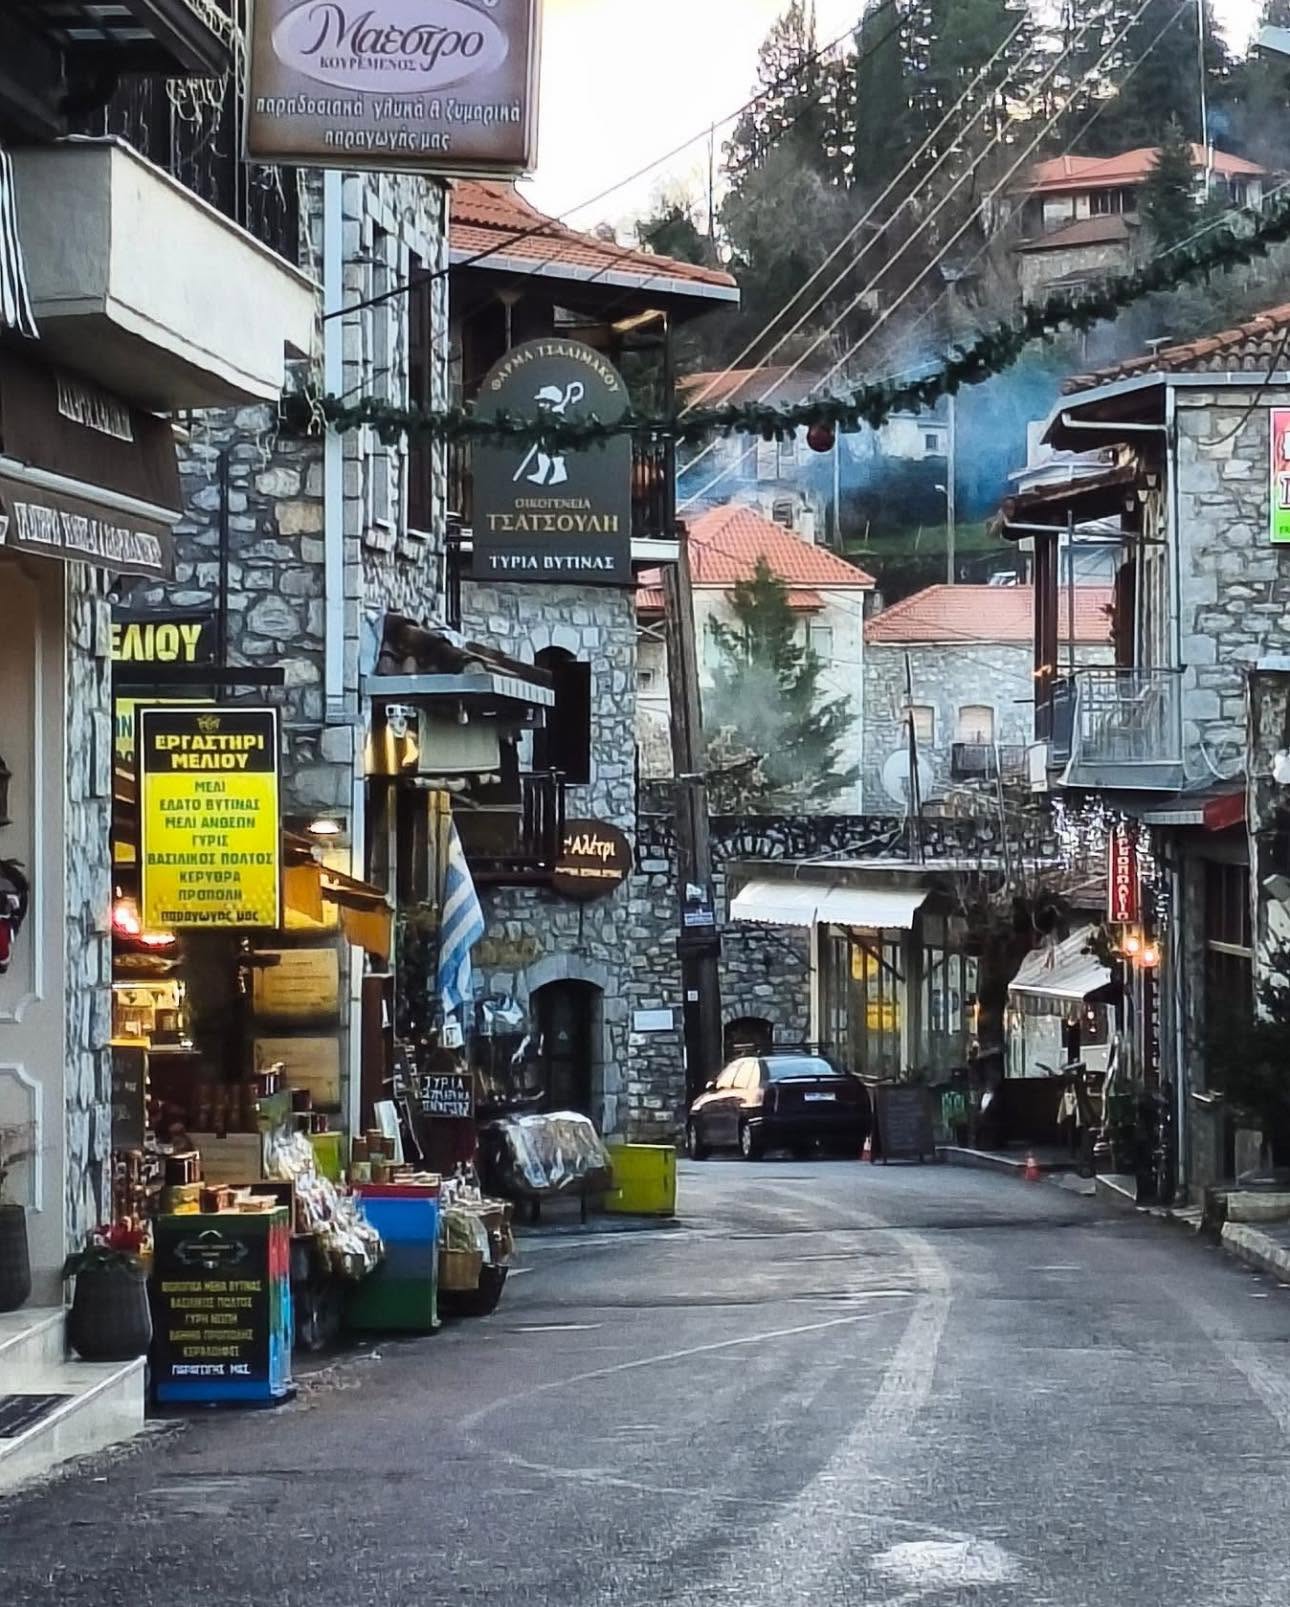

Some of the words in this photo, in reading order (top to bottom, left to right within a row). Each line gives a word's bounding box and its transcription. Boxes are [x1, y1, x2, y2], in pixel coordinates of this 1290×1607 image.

[319, 56, 417, 71] ΚΟΥΡΕΜΕΝΟΣ
[256, 94, 363, 120] παραδοσιακά
[373, 96, 424, 121] γλυκά
[445, 98, 521, 128] ζυμαρικά
[325, 125, 415, 150] παραγωγής
[421, 131, 450, 151] μας
[486, 513, 618, 532] ΤΣΑΤΣΟΥΛΗ
[489, 556, 538, 569] ΤΥΡΙΑ
[543, 556, 615, 569] ΒΥΤΙΝΑΣ
[155, 734, 264, 750] ΕΡΓΑΣΤΗΡΙ
[171, 753, 248, 769] ΜΕΛΙΟΥ
[194, 781, 226, 793] ΜΕΛΙ
[159, 799, 202, 811] ΕΛΑΤΟ
[206, 799, 260, 811] ΒΥΤΙΝΑΣ
[165, 817, 197, 829] ΜΕΛΙ
[192, 835, 229, 847] ΓΥΡΙΣ
[147, 853, 216, 866] ΒΑΣΙΛΙΚΟΣ
[221, 853, 273, 865] ΠΟΛΤΟΣ
[178, 889, 242, 901] ΠΡΟΠΟΛΗ
